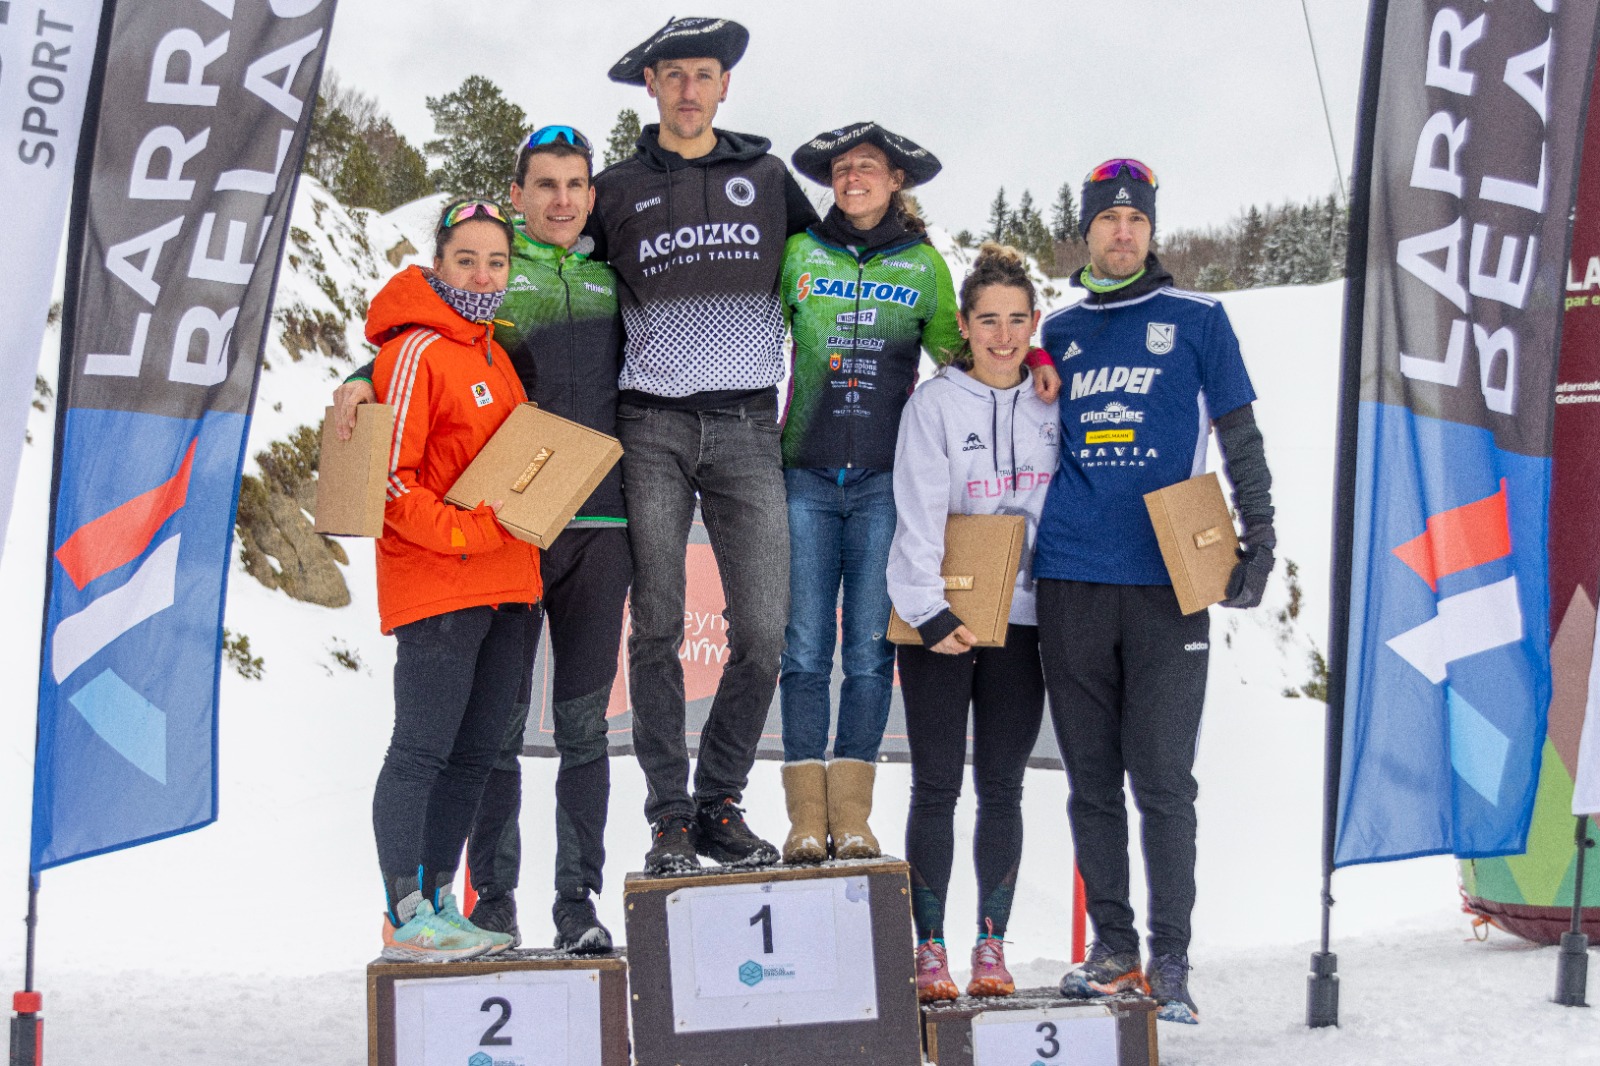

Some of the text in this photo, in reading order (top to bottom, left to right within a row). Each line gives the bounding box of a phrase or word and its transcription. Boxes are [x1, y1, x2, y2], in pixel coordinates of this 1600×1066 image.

[18, 8, 74, 169] SPORT
[84, 0, 236, 378] LARR
[1396, 0, 1488, 387] LARR
[1469, 0, 1555, 416] BELA
[639, 223, 760, 263] AGOIZKO
[708, 251, 760, 261] TALDEA
[812, 278, 920, 309] SALTOKI
[1565, 296, 1588, 312] par
[827, 336, 885, 348] Bianchi
[1070, 366, 1157, 401] MAPEI
[1556, 380, 1600, 393] afarroak
[1072, 446, 1158, 459] RAVIA
[966, 472, 1051, 499] EUROP
[684, 611, 725, 635] eyn
[1184, 642, 1209, 651] adidas
[749, 904, 774, 954] 1
[479, 996, 512, 1046] 2
[1035, 1021, 1060, 1059] 3
